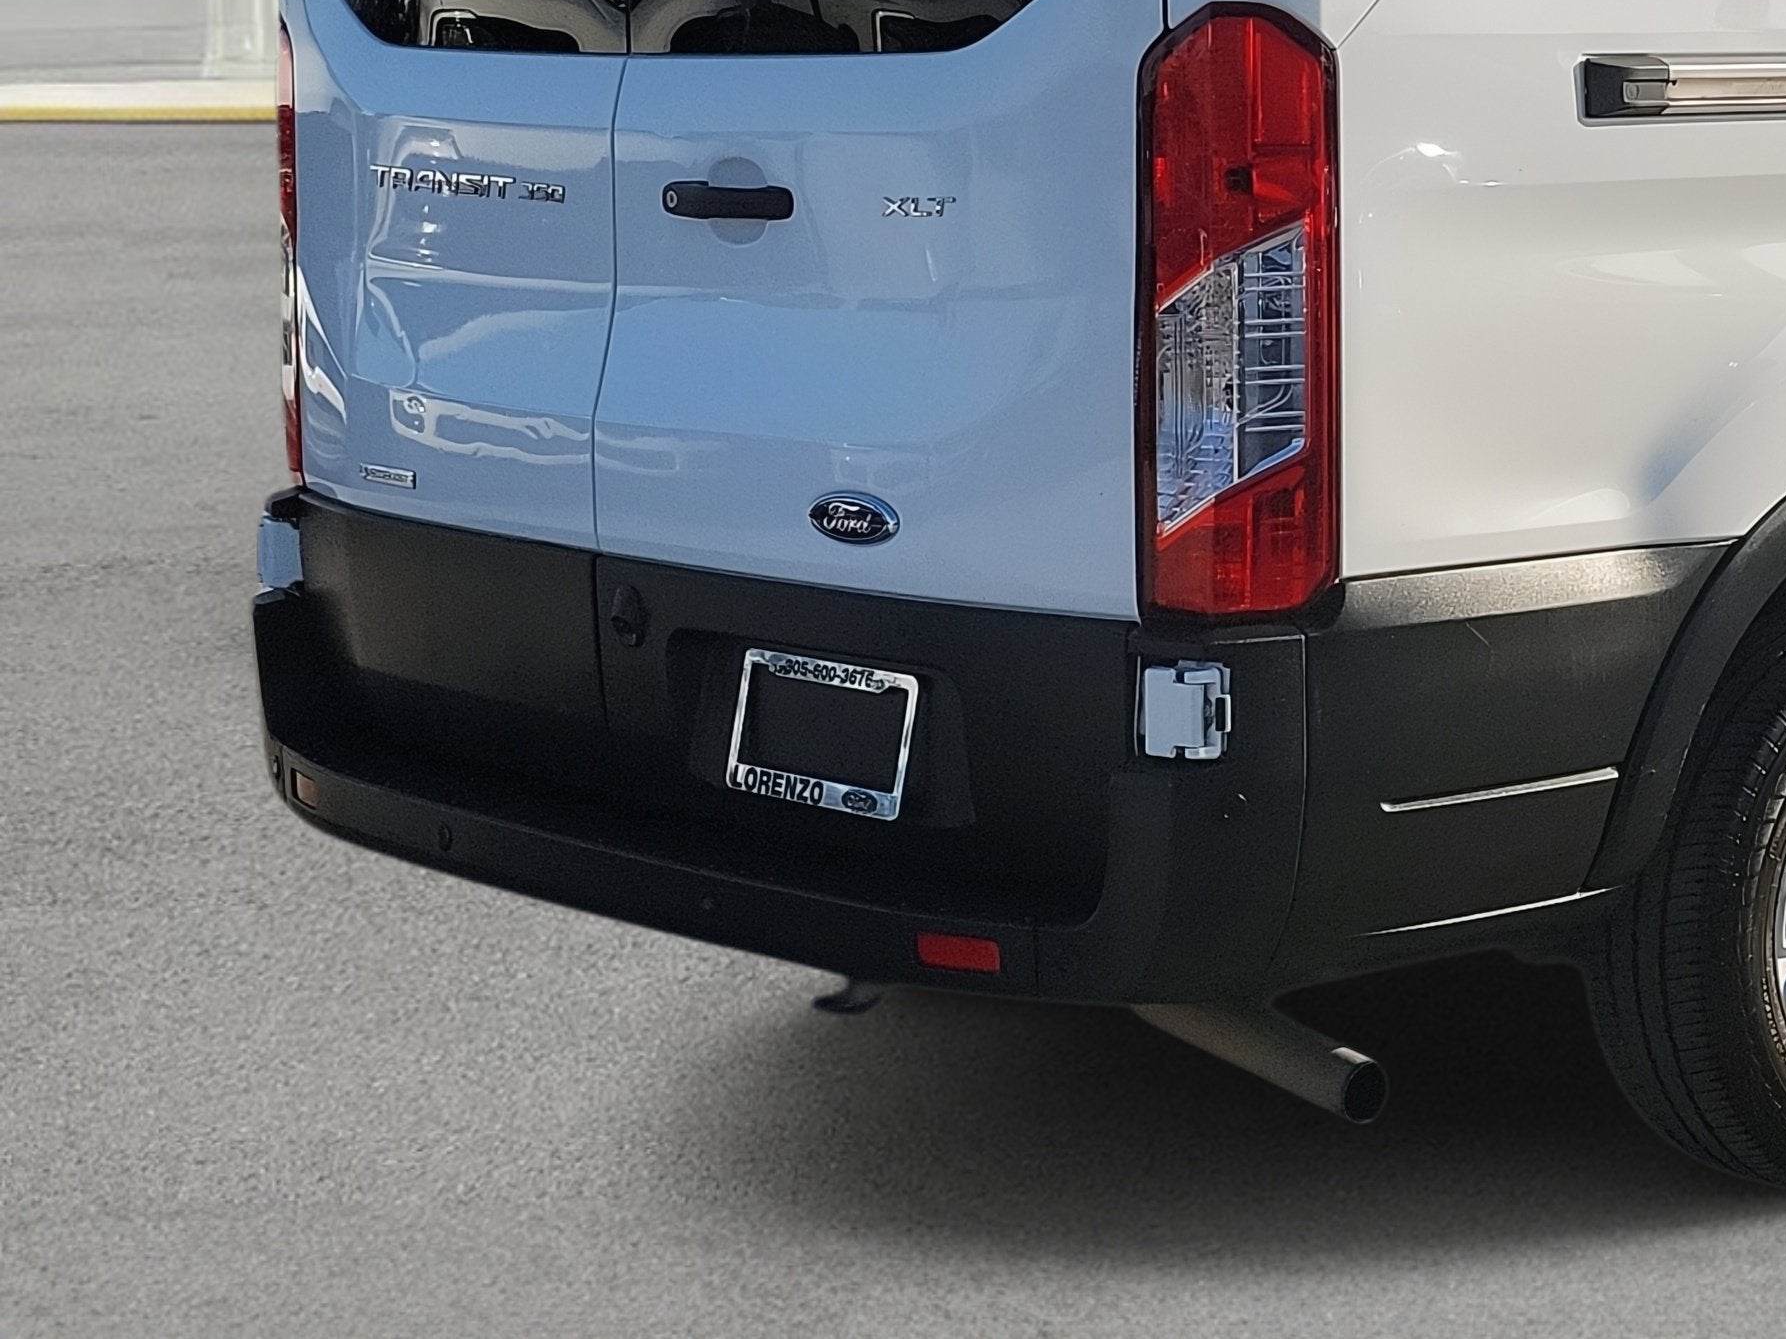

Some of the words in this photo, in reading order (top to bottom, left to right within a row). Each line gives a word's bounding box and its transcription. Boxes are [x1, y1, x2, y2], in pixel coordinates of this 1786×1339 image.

[369, 164, 516, 200] TRANSIT
[881, 196, 957, 217] XLT
[823, 502, 872, 533] Ford
[731, 763, 825, 806] LORENZO
